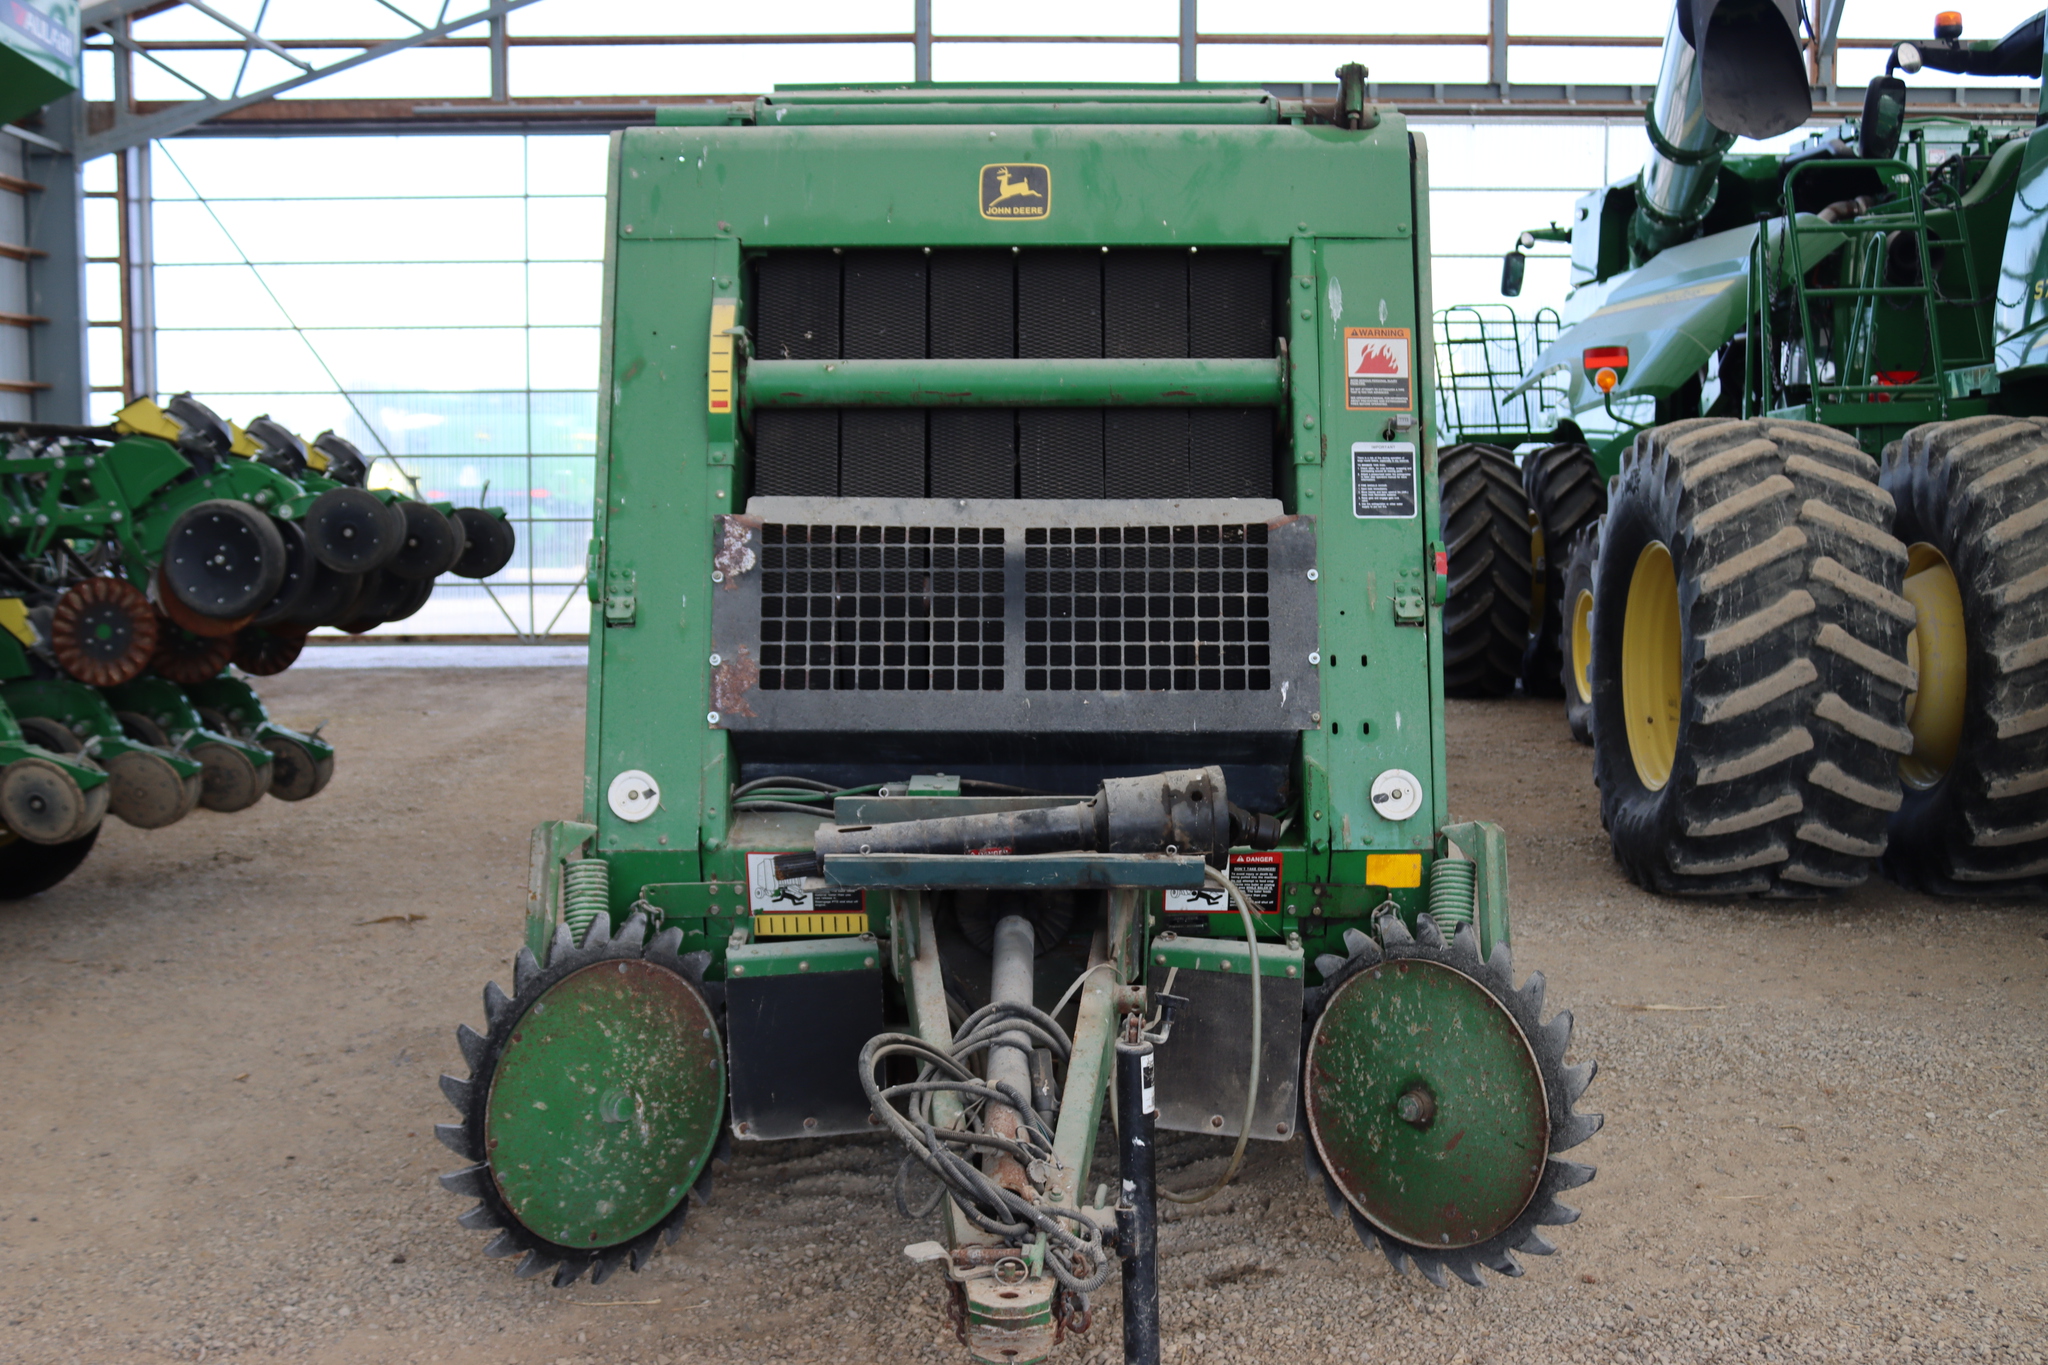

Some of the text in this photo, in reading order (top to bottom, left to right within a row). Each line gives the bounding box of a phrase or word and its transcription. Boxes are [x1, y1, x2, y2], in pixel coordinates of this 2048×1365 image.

[986, 206, 1043, 215] JOHN DEERE
[1359, 329, 1404, 337] WARNING
